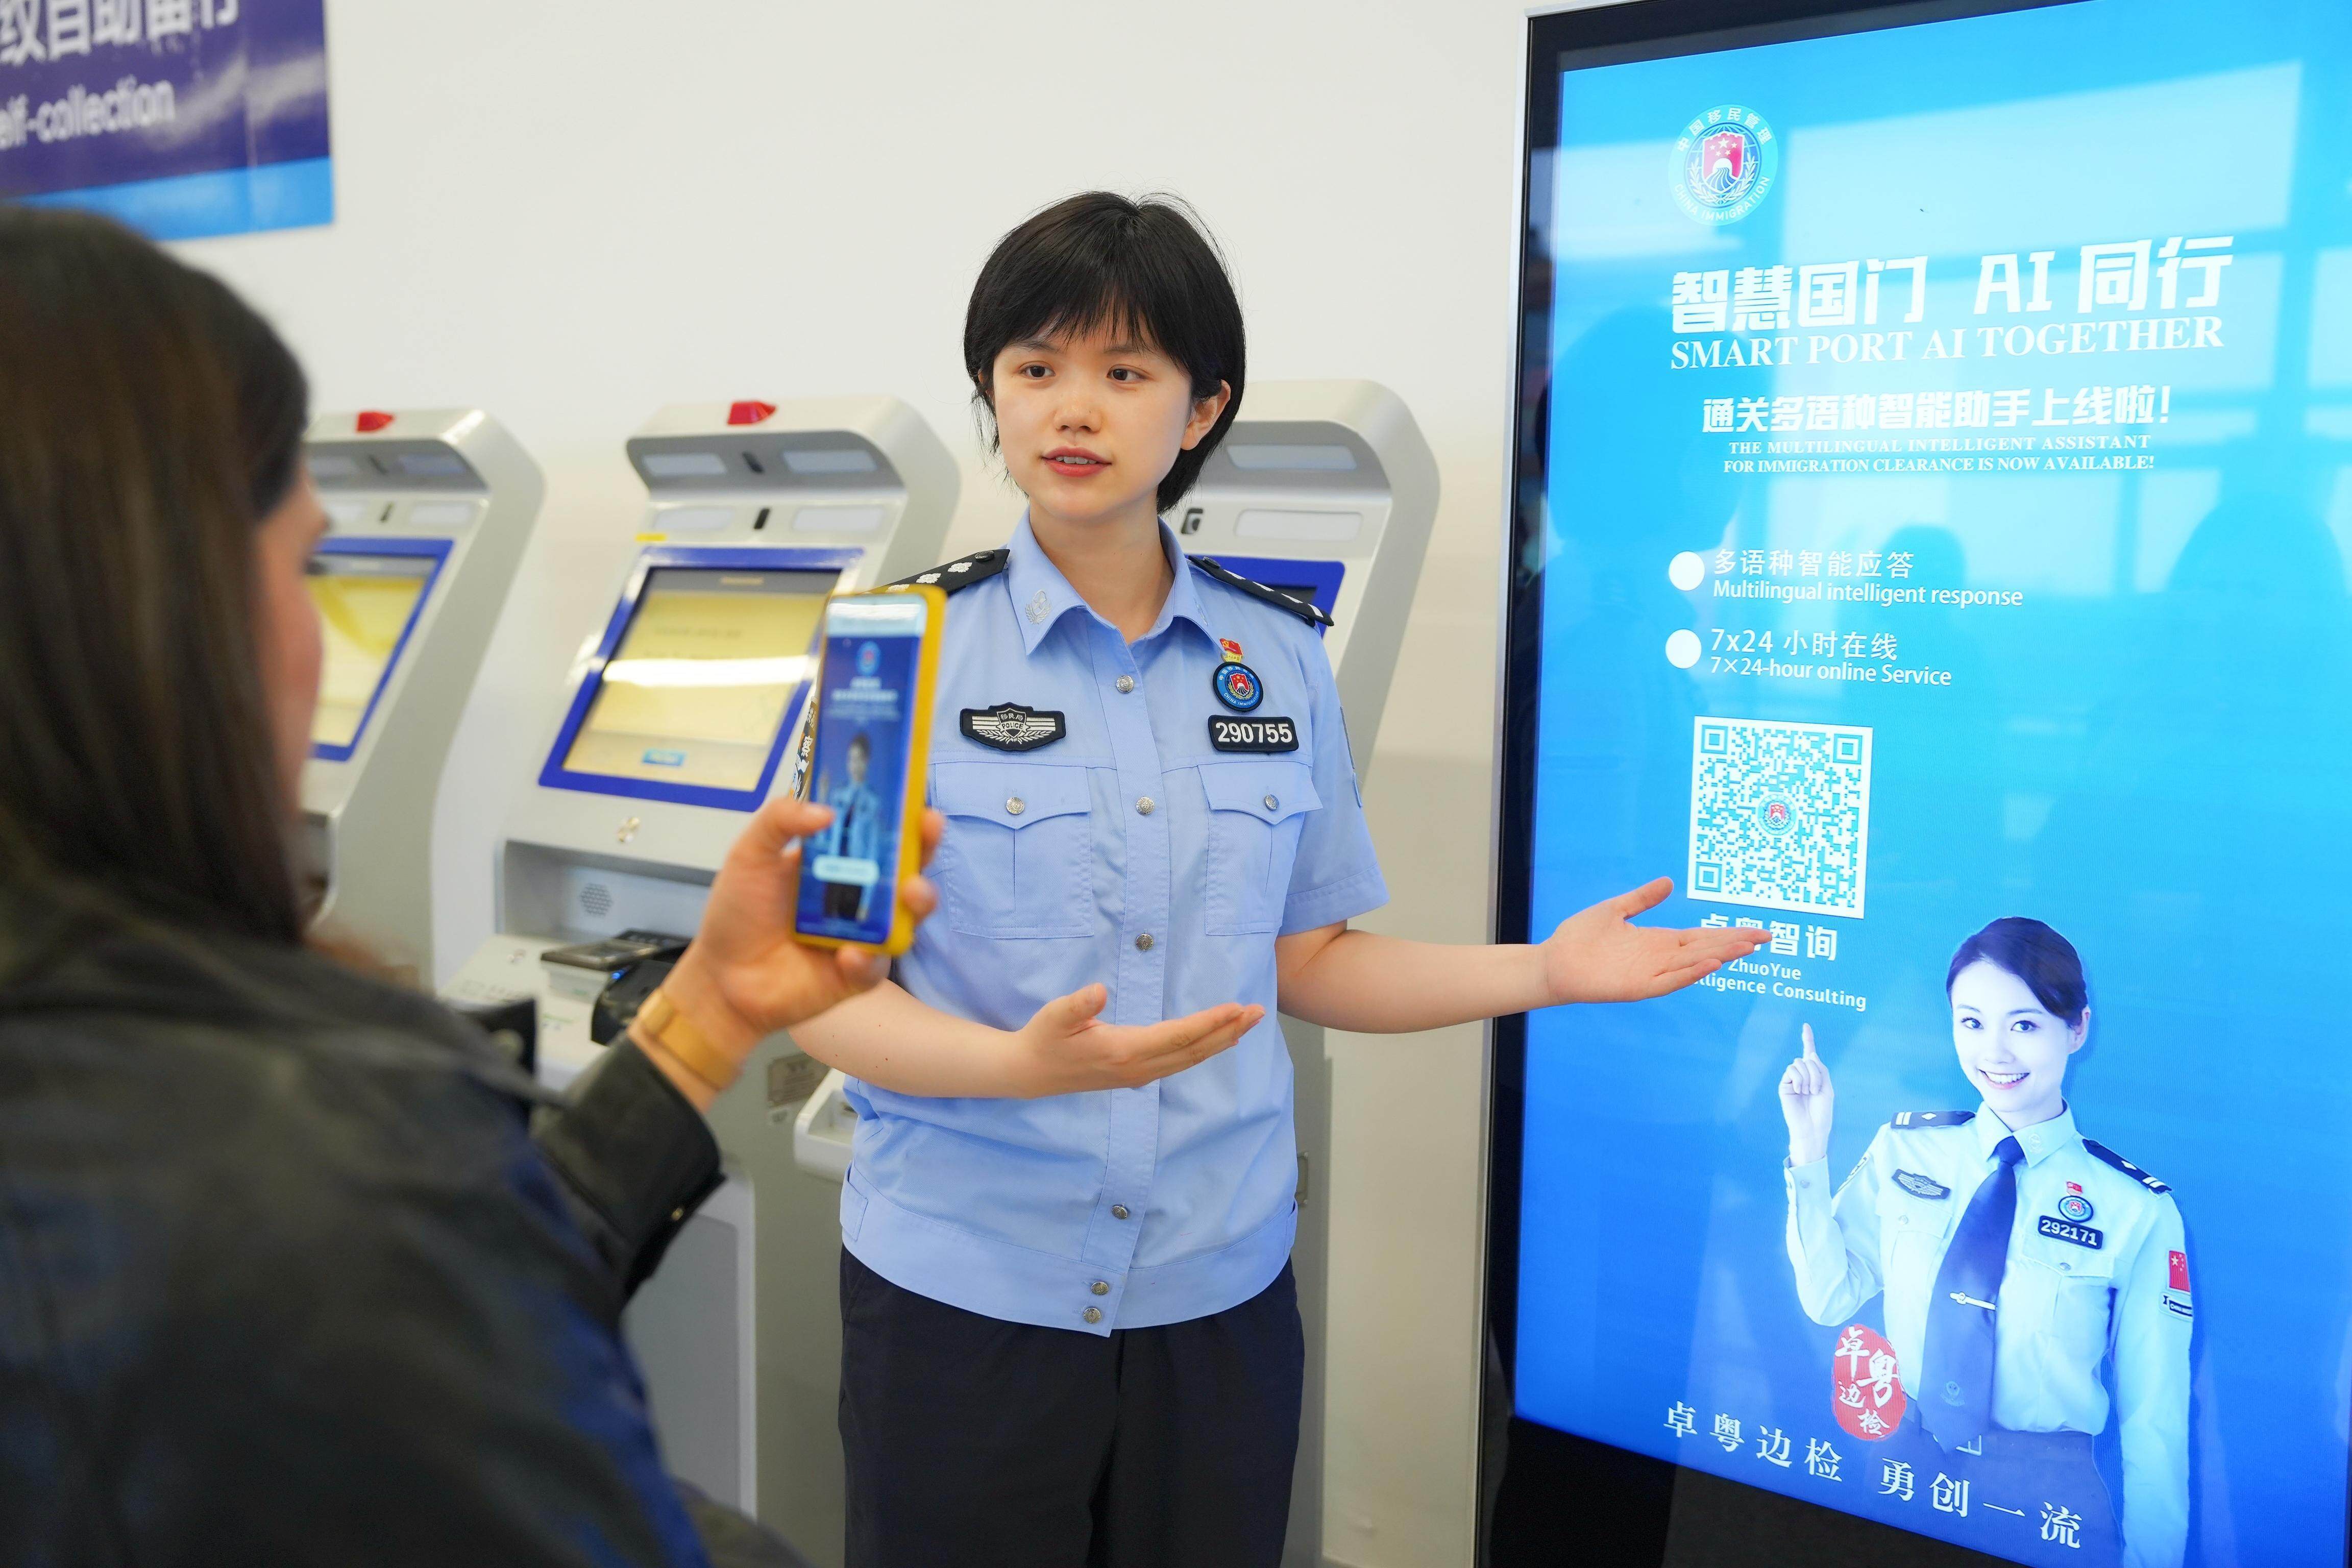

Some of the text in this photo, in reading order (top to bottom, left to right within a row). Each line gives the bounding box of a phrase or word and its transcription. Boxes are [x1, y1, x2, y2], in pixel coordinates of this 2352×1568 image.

[1677, 107, 1773, 152] 中国移民管理
[1674, 176, 1770, 220] CHINA IMMIGRATION
[1672, 236, 2234, 334] 智慧国门 AI 同行
[1671, 315, 2224, 370] SMART PORT AI TOGETHER
[1702, 385, 2170, 433] 通关多语种智能助手上线啦！
[1729, 435, 2151, 454] THE MULTILINGUAL INTELLIGENT ASSISTANT
[1724, 455, 2154, 473] FOR IMMIGRATION CLEARANCE IS NOW AVAILABLE!
[1712, 549, 1914, 579] 多语种智能应答
[1713, 579, 2023, 609] Multilingual intelligent response
[1710, 628, 1898, 660] 7x24 小时在线
[1817, 661, 1876, 683] online
[1881, 665, 1952, 687] Service
[1224, 693, 1236, 704] CHINA
[1215, 722, 1292, 743] 290755
[1728, 958, 1801, 981] ZhuoYue
[1694, 973, 1866, 1012] lligence Consulting
[2041, 1219, 2097, 1246] 292171
[1663, 1402, 2083, 1549] 卓粤边检 勇创一流
